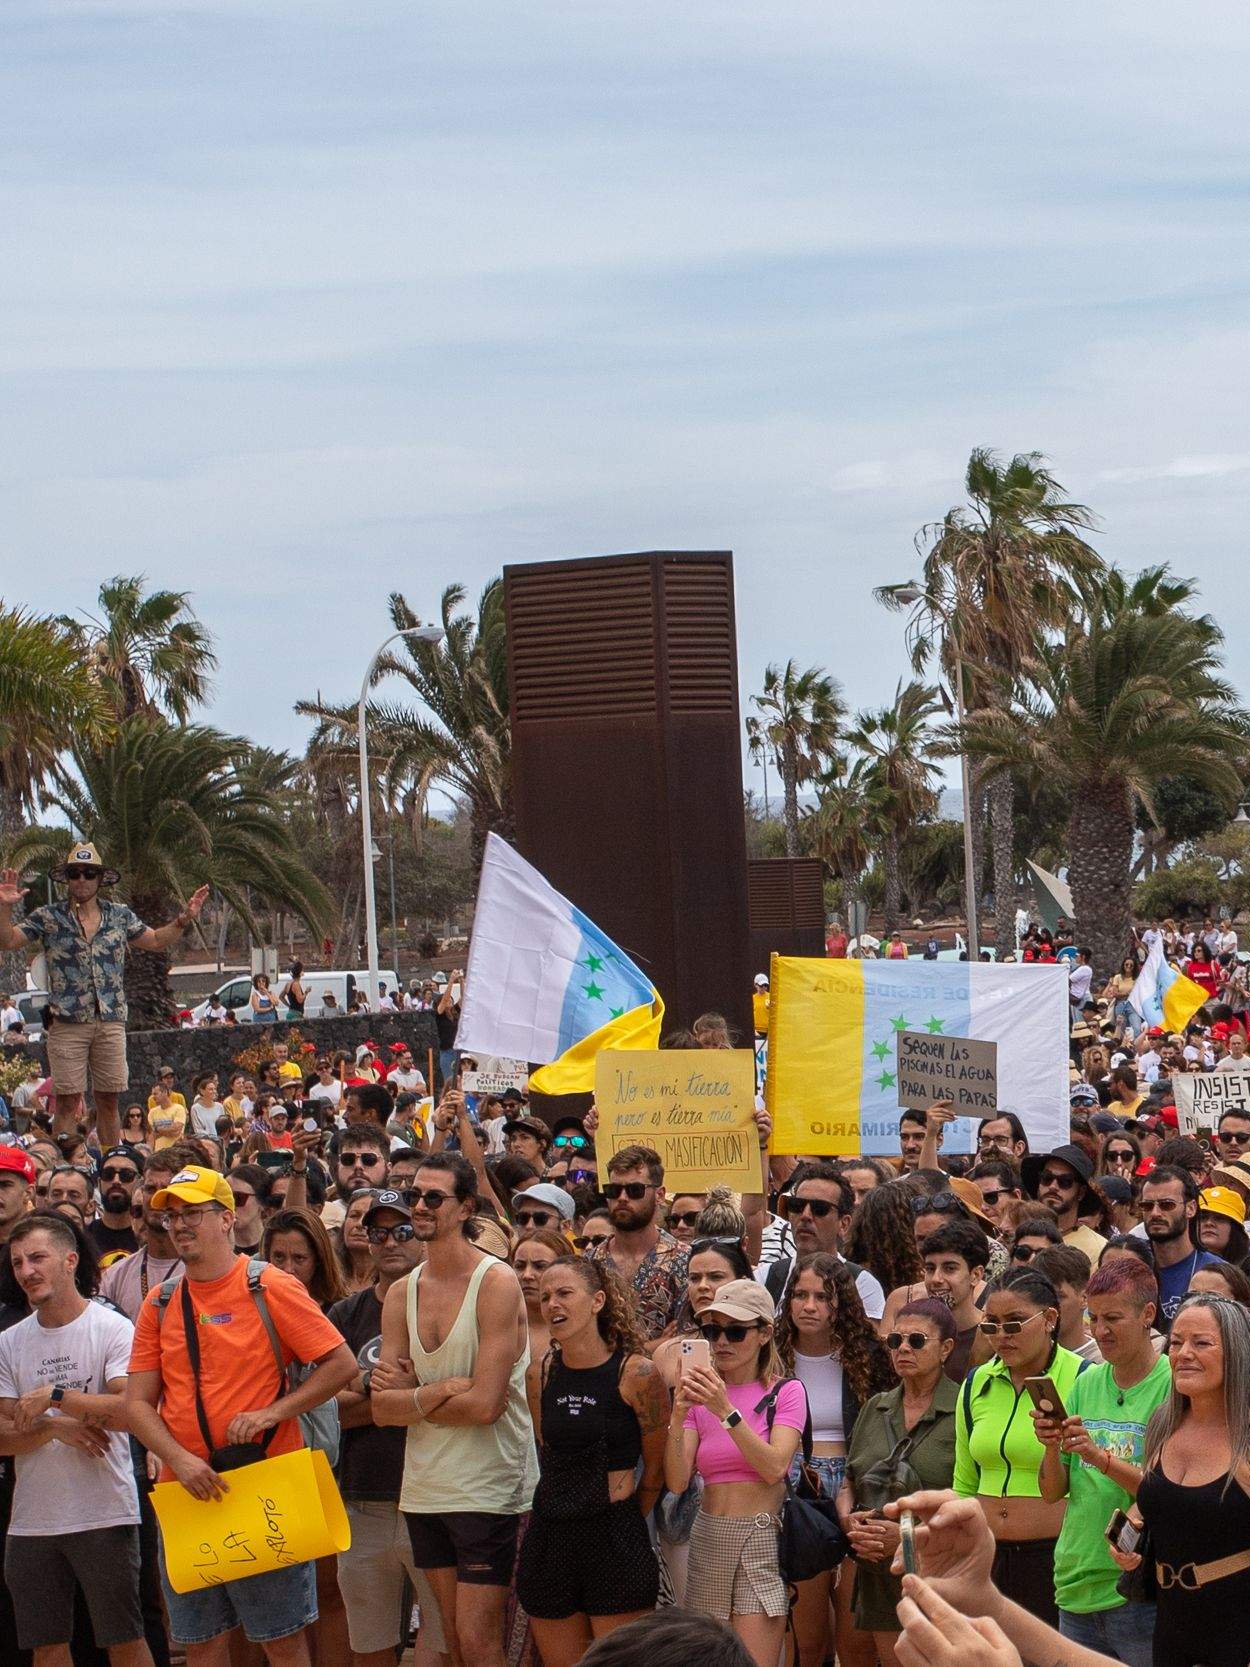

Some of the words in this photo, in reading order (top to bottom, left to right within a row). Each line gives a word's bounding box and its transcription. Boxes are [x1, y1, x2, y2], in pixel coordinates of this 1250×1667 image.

[643, 1084, 656, 1099] es
[684, 1072, 732, 1097] tierra
[959, 1065, 994, 1080] AGUA
[901, 1081, 927, 1097] PARA
[932, 1084, 955, 1100] LAS
[959, 1088, 997, 1108] PAPAS
[614, 1112, 648, 1135] pero
[651, 1112, 662, 1127] es
[666, 1102, 704, 1127] tierra
[665, 1133, 743, 1168] MASIFICACIÓN
[37, 1367, 49, 1376] NO
